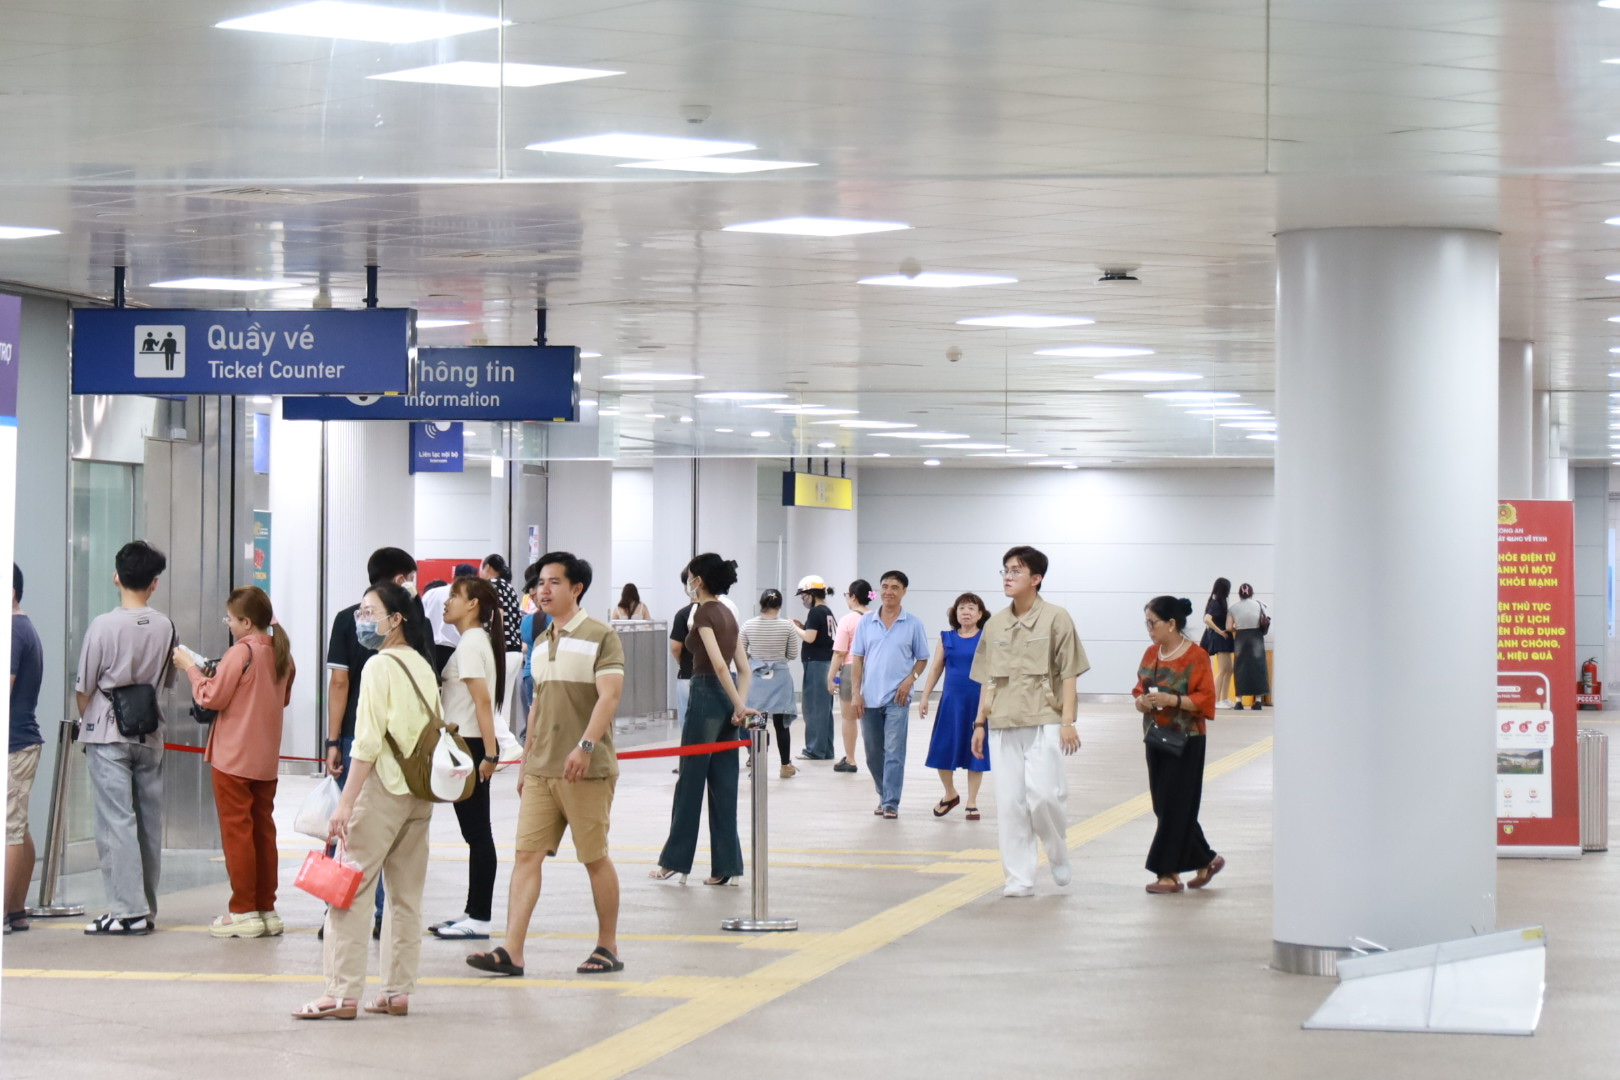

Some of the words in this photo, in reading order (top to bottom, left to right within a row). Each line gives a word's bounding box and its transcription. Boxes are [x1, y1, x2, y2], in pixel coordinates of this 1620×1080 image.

[207, 321, 276, 356] Quầy
[284, 323, 315, 350] vé
[207, 360, 264, 379] Ticket
[269, 360, 346, 379] Counter
[417, 360, 478, 388] hông
[486, 360, 515, 382] tin
[1519, 564, 1529, 574] VÌ
[1531, 564, 1553, 575] MỘT
[1528, 578, 1558, 588] MẠNH
[1531, 602, 1552, 612] TỤC
[1527, 615, 1550, 625] LỊCH
[1537, 627, 1567, 638] DỤNG
[1507, 650, 1529, 662] HIỆU
